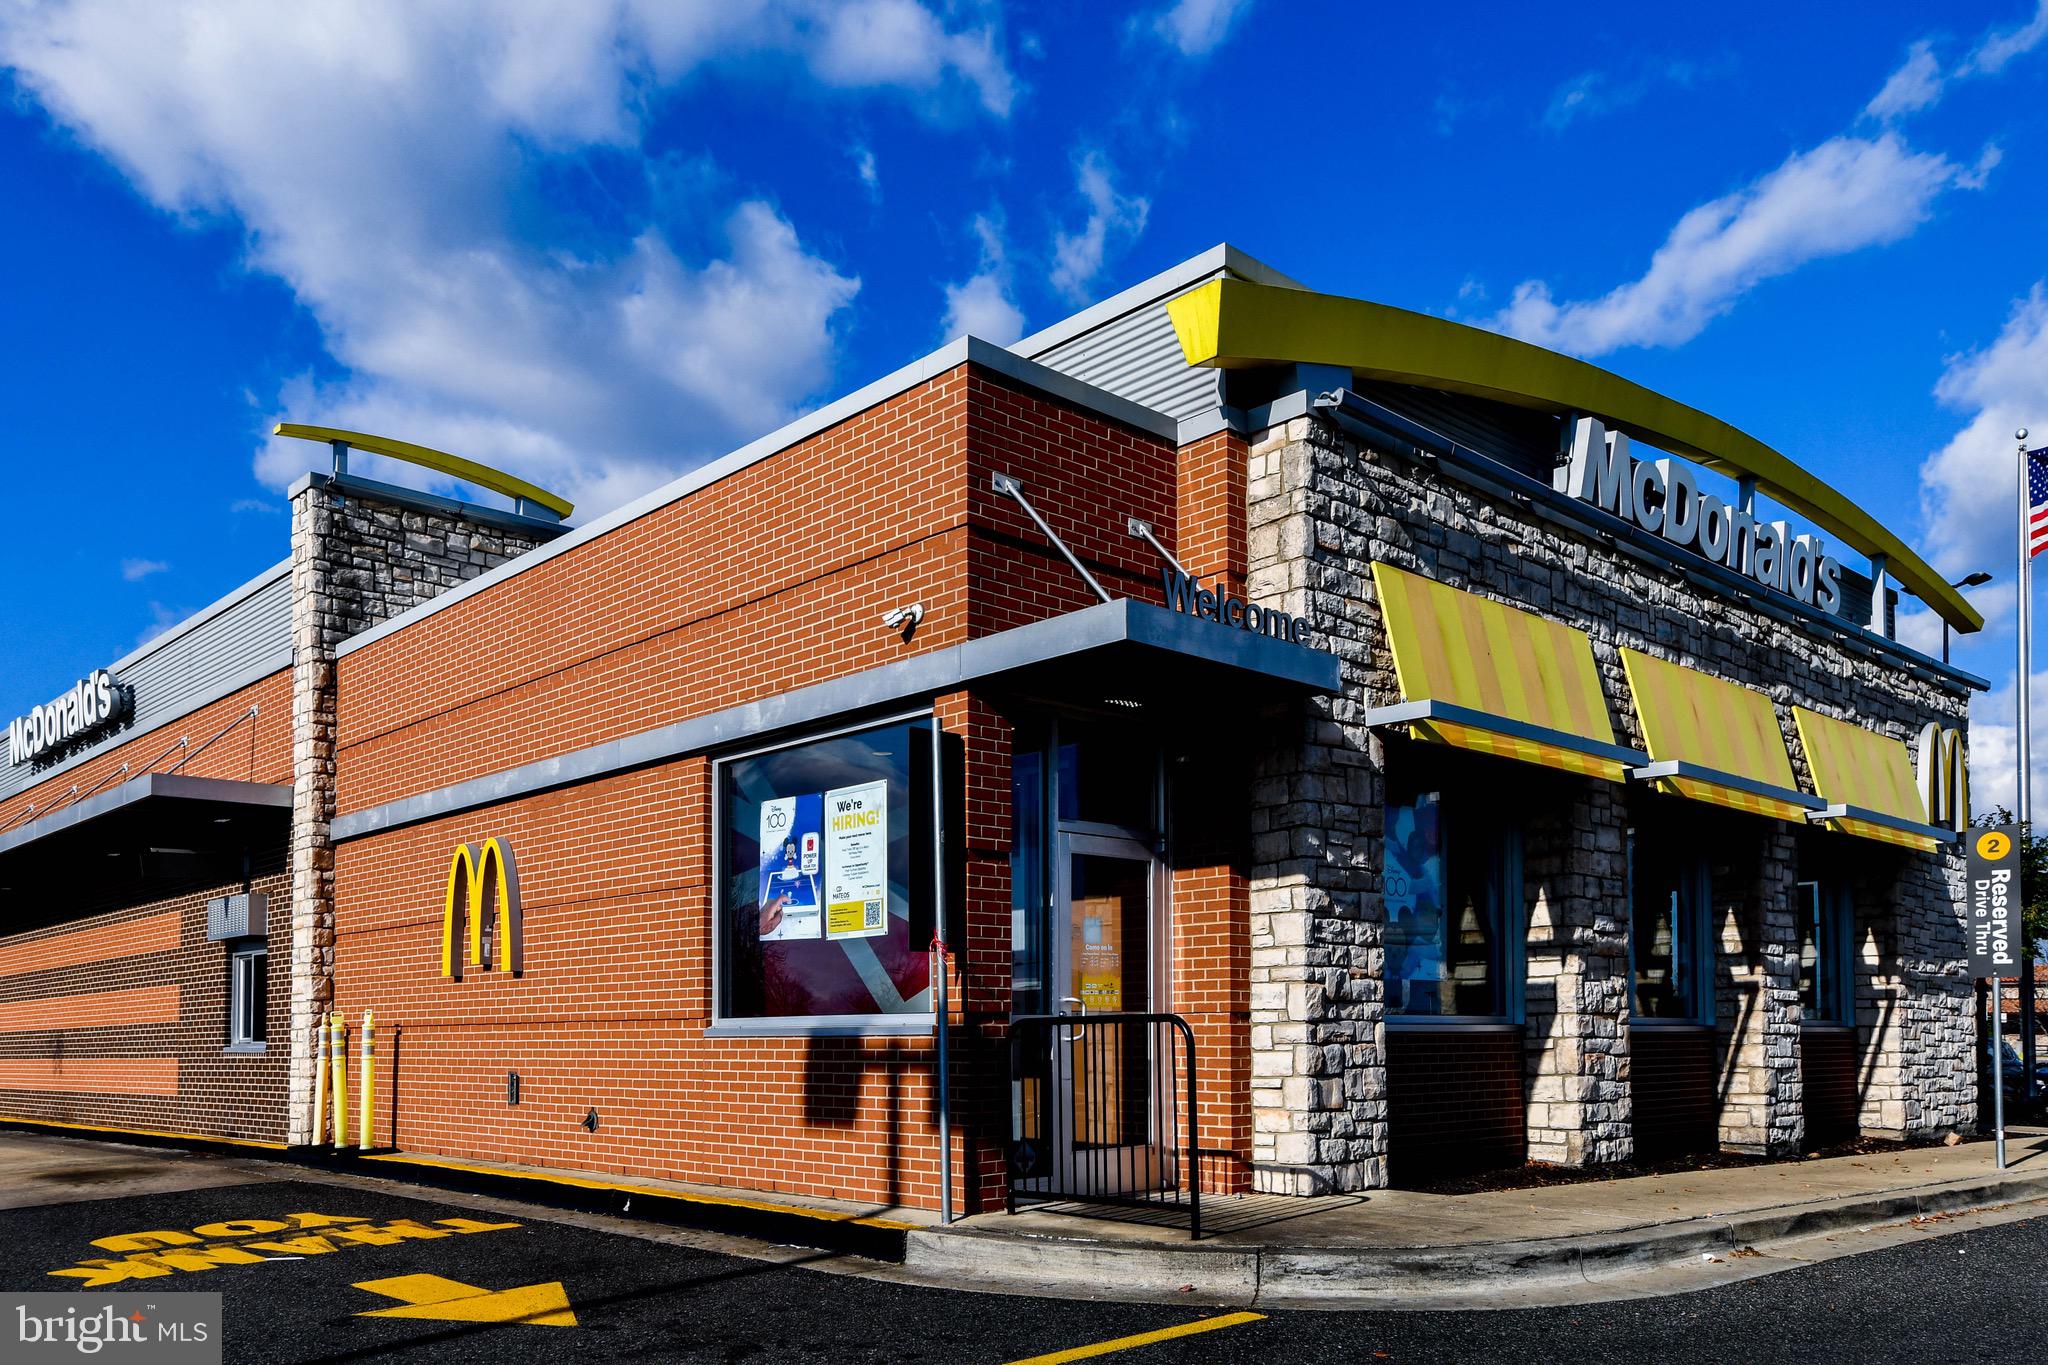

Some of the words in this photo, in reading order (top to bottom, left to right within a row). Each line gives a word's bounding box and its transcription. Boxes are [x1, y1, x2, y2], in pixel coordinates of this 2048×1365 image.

[1566, 416, 1842, 616] McDonald's
[1162, 567, 1311, 648] Welcome
[8, 668, 116, 768] McDonald's
[766, 812, 787, 829] 100
[832, 807, 880, 831] HIRING!
[836, 798, 862, 813] We're
[1987, 839, 2000, 853] 2
[832, 892, 850, 900] MATEOS
[1975, 879, 1991, 917] Drive
[1991, 868, 2014, 965] Reserved
[1975, 921, 1991, 956] Thru
[89, 1211, 376, 1253] YOU
